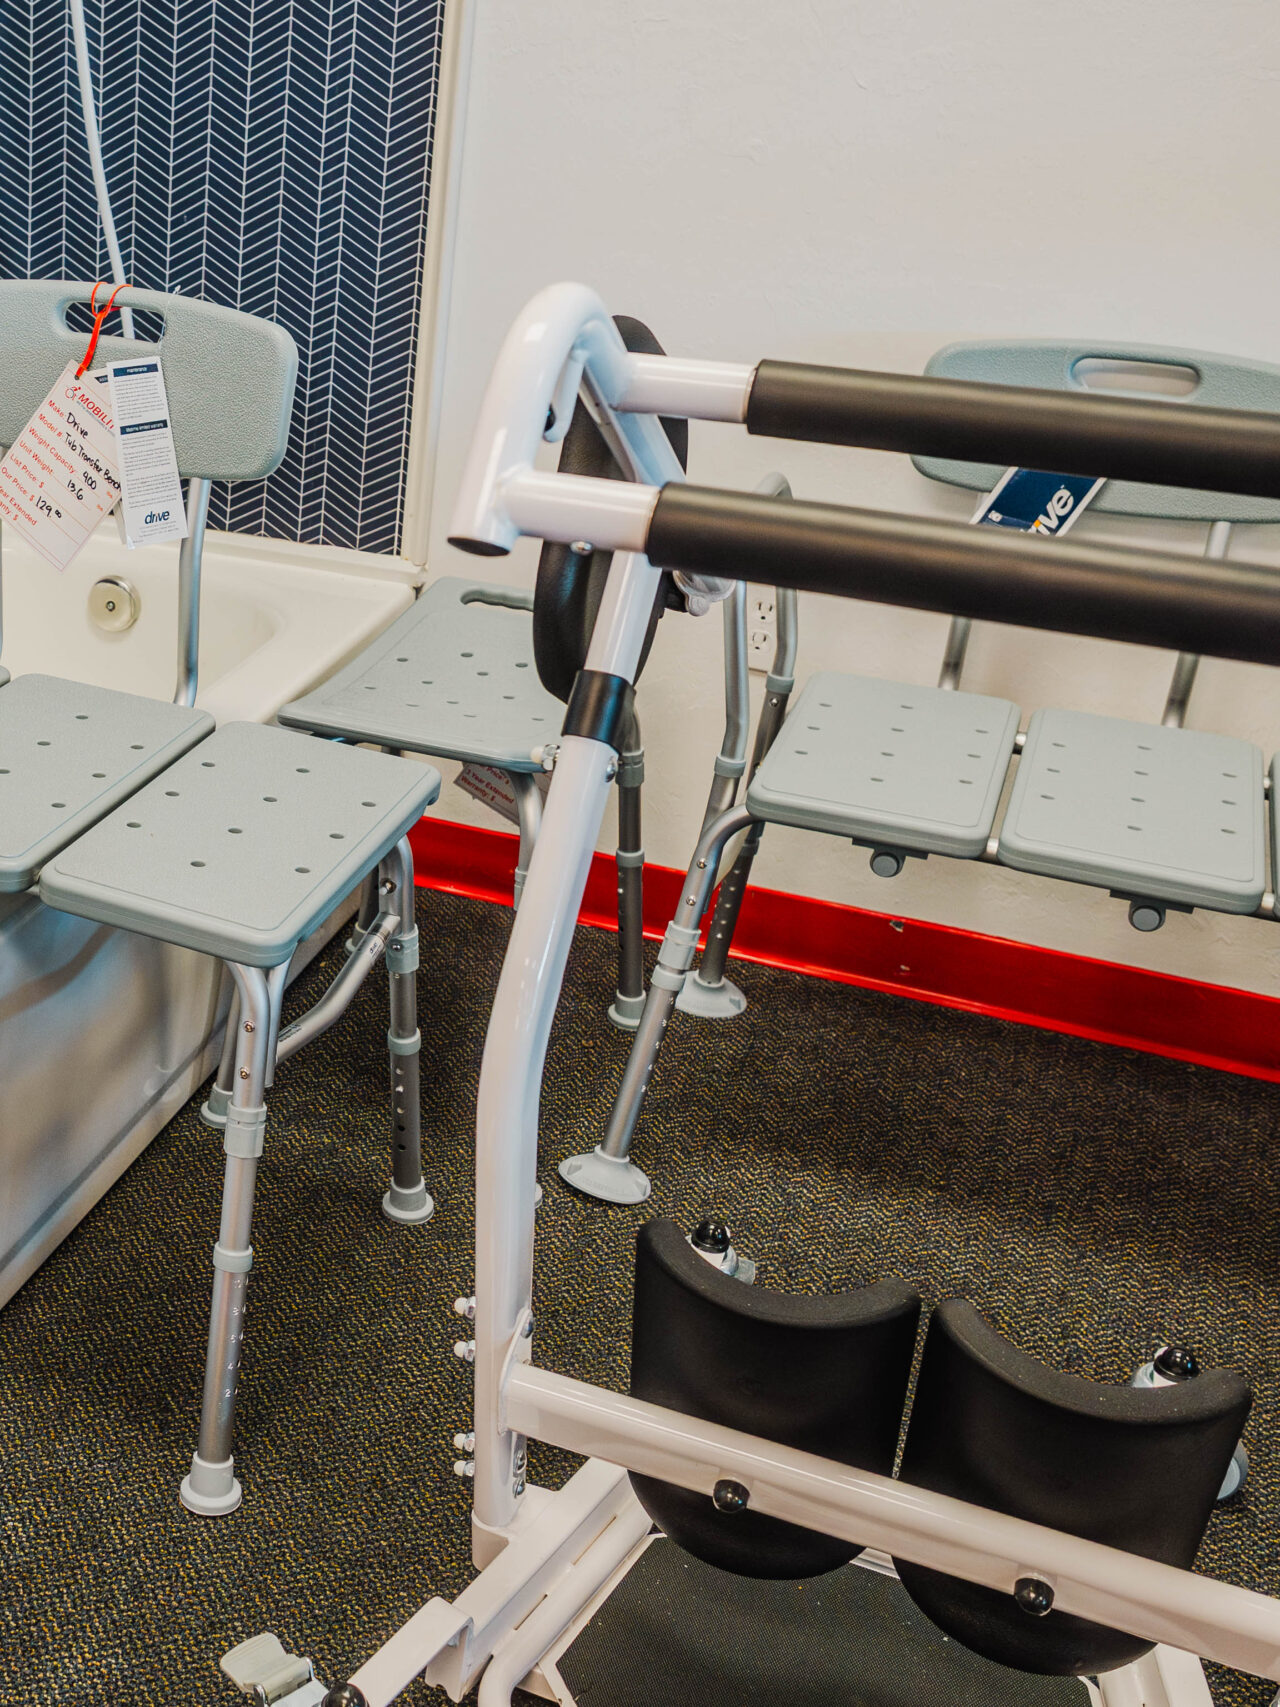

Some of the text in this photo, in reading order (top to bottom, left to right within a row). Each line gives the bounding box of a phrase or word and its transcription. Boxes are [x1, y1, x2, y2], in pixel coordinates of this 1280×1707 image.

[48, 400, 66, 418] Make:
[66, 412, 88, 439] Drive
[29, 427, 50, 448] Weight
[38, 413, 57, 432] Model
[65, 432, 77, 452] Tub
[78, 444, 103, 472] Transfer
[19, 440, 32, 456] Unit
[10, 454, 22, 468] List
[1, 466, 12, 480] Our
[9, 497, 37, 526] Extended
[144, 510, 170, 524] drive
[485, 781, 515, 804] Extended
[225, 1389, 231, 1398] 2
